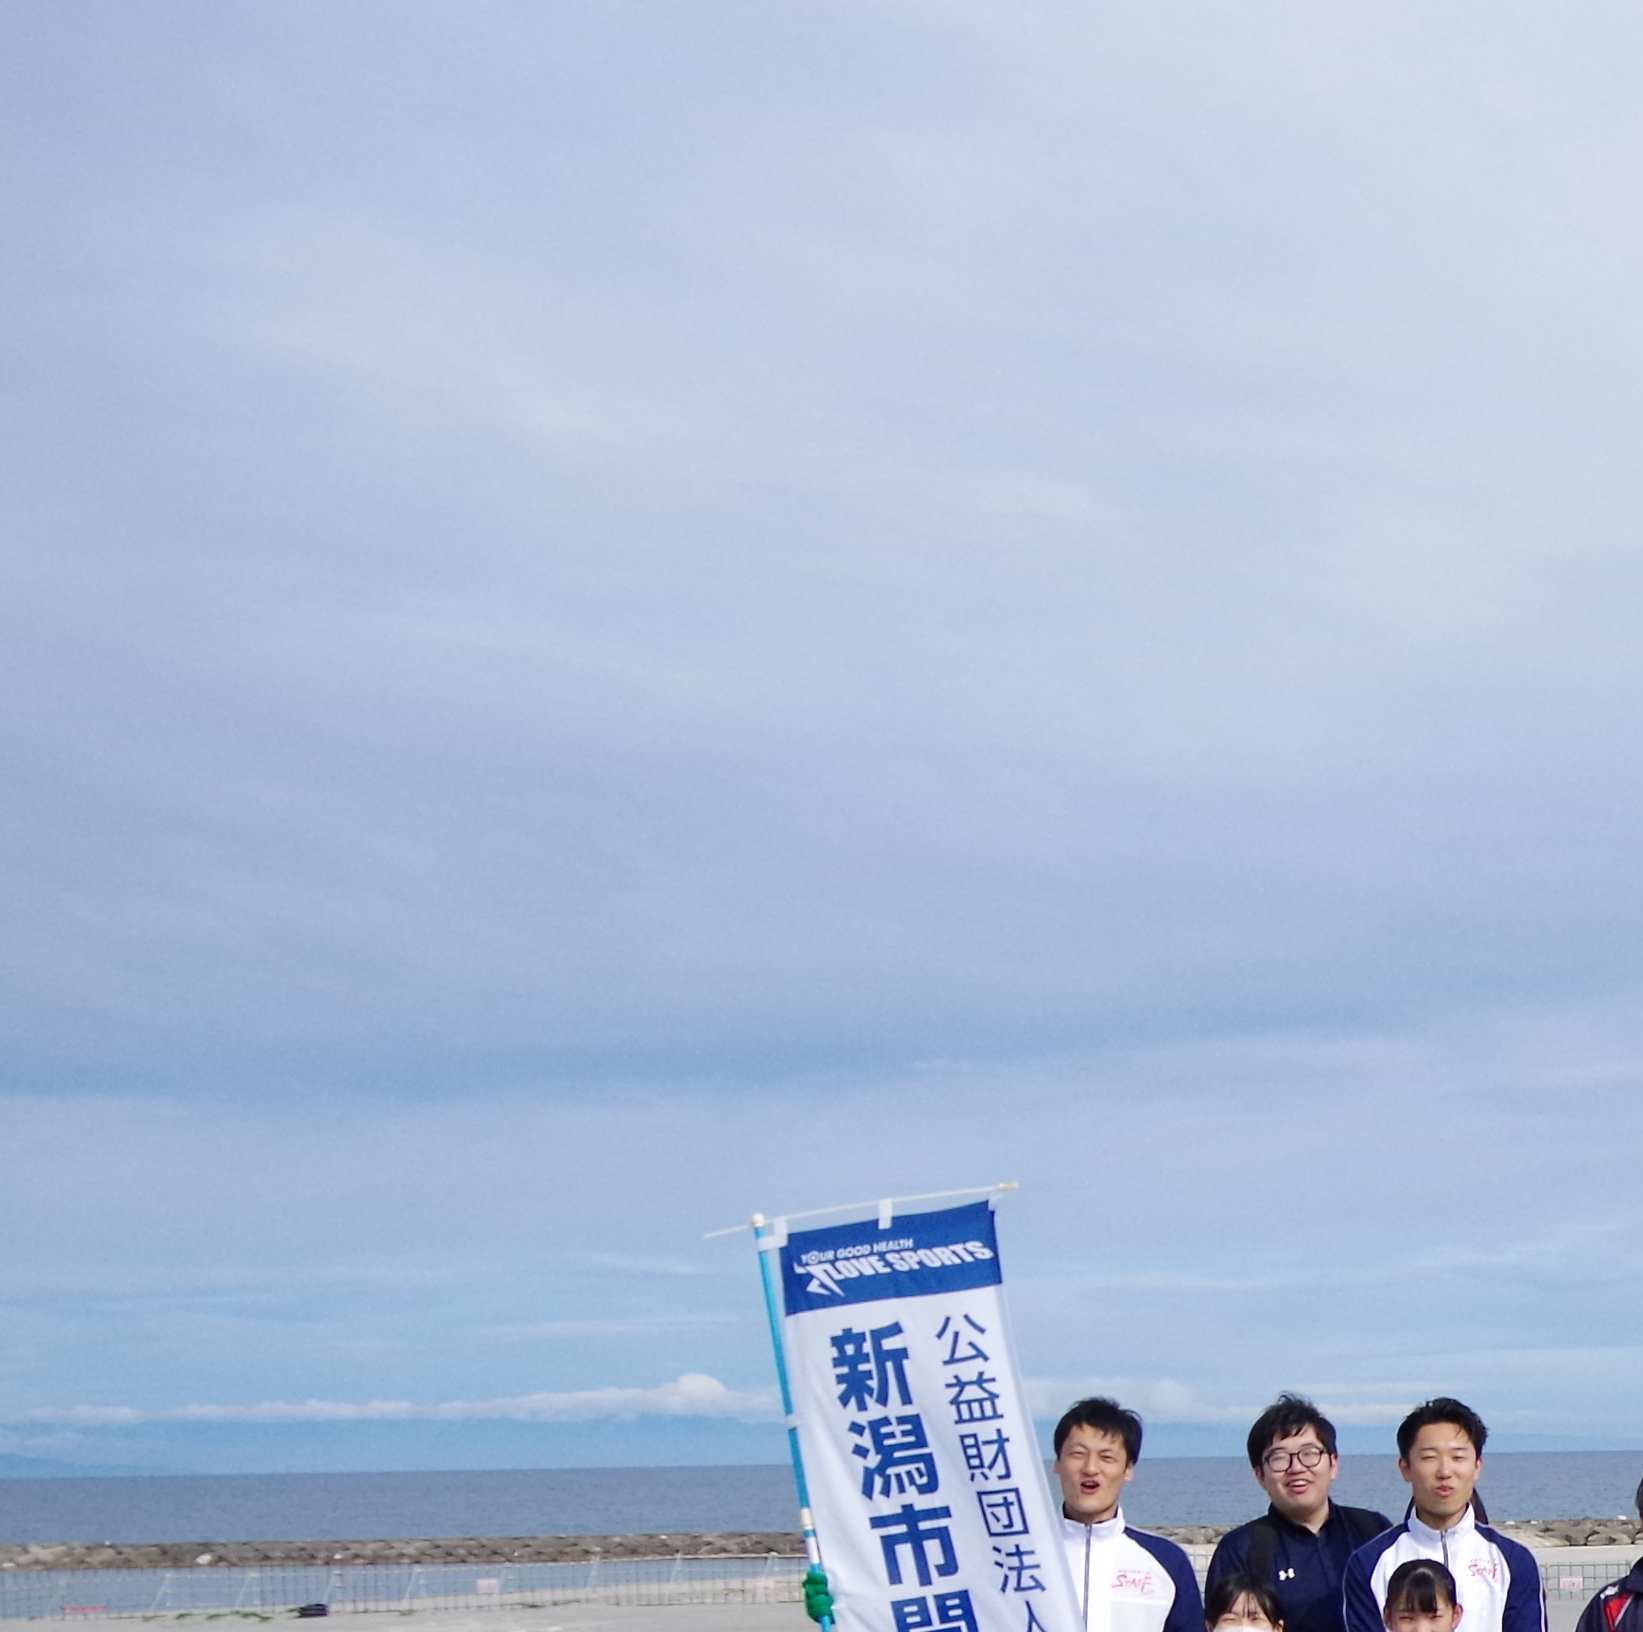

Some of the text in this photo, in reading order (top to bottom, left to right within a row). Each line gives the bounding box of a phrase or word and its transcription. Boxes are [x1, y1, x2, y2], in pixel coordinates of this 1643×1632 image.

[800, 1238, 914, 1265] YOUR GOOD HEALTH
[889, 1240, 995, 1271] SPORTS
